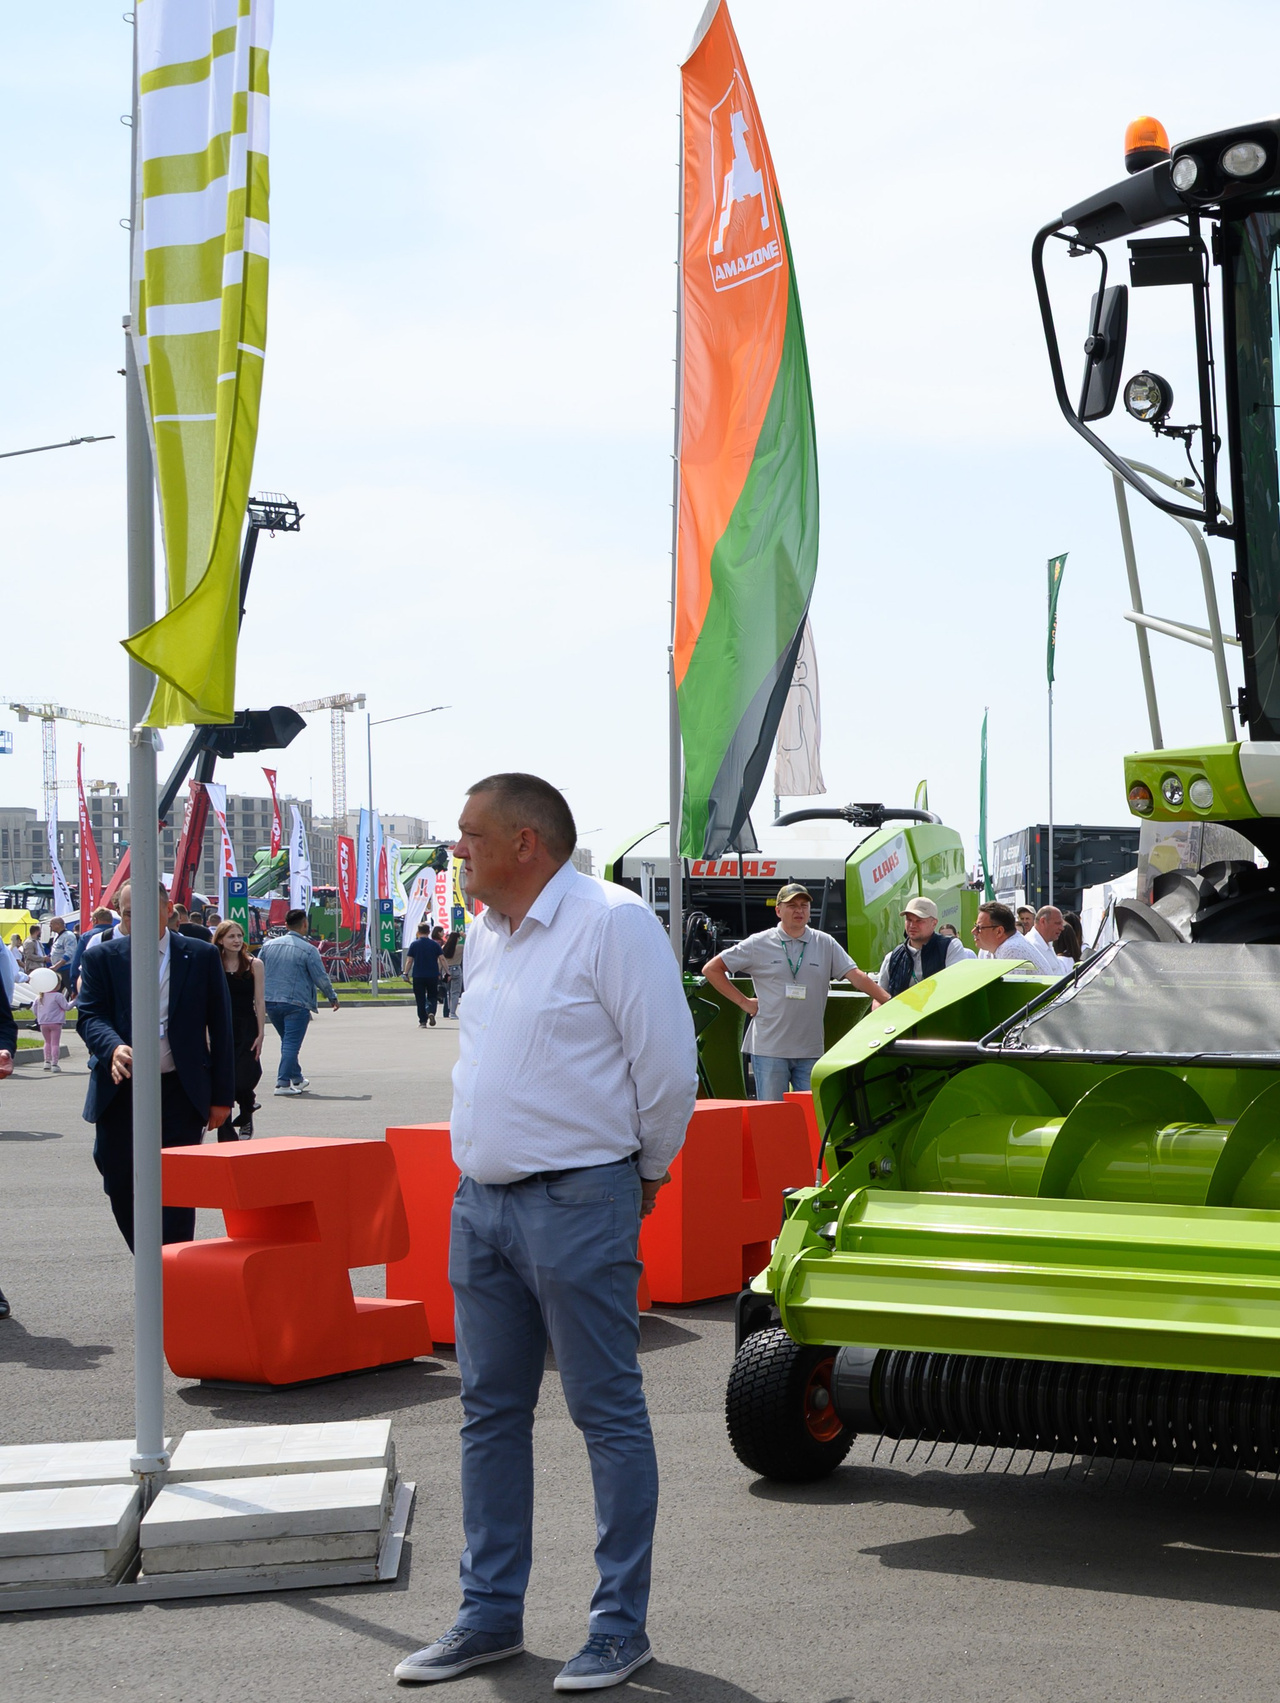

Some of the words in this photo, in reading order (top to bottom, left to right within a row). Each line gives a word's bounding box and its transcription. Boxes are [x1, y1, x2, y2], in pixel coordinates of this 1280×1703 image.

[715, 239, 780, 282] AMAZONE
[183, 795, 194, 836] SANY
[690, 860, 778, 877] CLAAS
[872, 850, 899, 884] CLAAS
[234, 882, 243, 893] P
[383, 903, 390, 911] P
[435, 869, 449, 937] ИРОВЕ
[230, 906, 246, 919] M
[381, 920, 393, 930] M
[384, 933, 391, 942] 5
